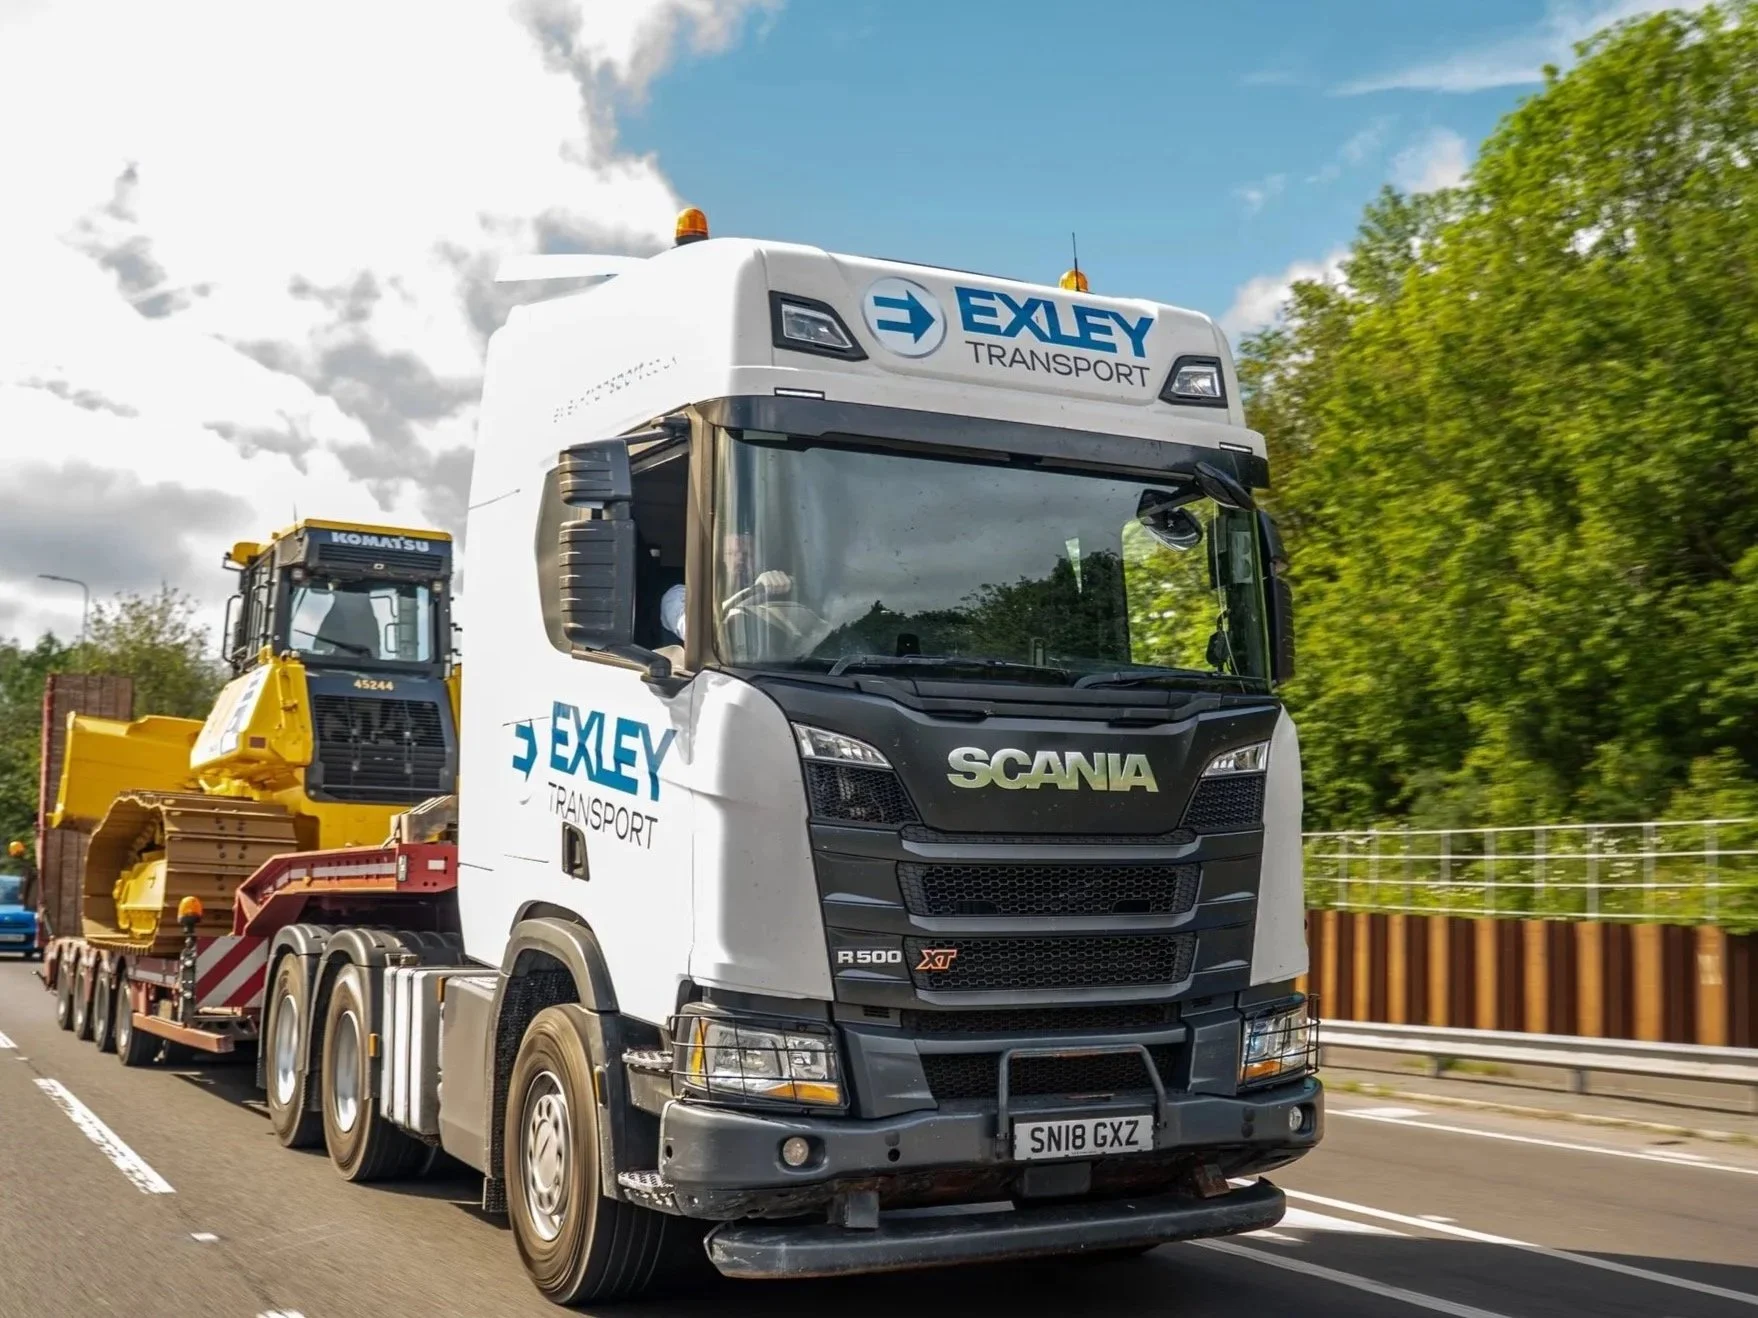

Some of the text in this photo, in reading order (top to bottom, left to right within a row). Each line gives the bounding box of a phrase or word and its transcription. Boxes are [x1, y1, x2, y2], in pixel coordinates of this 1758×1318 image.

[954, 286, 1154, 358] EXLEY
[965, 341, 1150, 387] TRANSPORT
[331, 532, 429, 552] KOMATSU
[353, 679, 394, 691] 45244
[550, 700, 678, 802] EXLEY
[947, 747, 1159, 792] SCANIA
[548, 781, 658, 849] TRANSPORT
[915, 949, 958, 972] XT
[1030, 1119, 1139, 1153] SN18 GXZ
